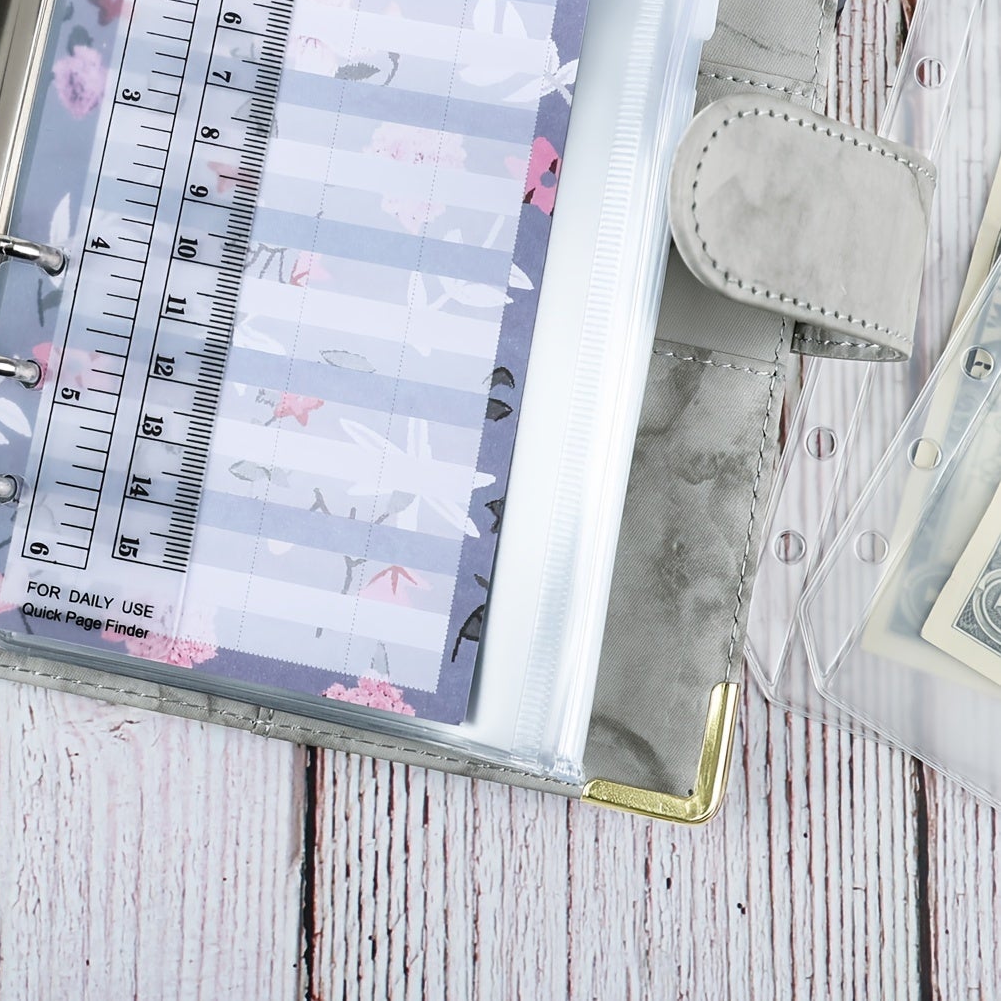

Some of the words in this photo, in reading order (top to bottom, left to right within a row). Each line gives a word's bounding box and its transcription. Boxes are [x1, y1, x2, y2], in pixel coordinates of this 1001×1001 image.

[223, 11, 242, 25] 6
[212, 69, 232, 83] 7
[121, 88, 141, 102] 3
[200, 125, 220, 139] 8
[189, 184, 209, 198] 9
[91, 236, 111, 250] 4
[177, 235, 199, 259] 10
[164, 294, 187, 315] 11
[153, 353, 175, 377] 12
[61, 386, 81, 401] 5
[142, 413, 164, 437] 13
[129, 473, 152, 497] 14
[29, 541, 50, 556] 6
[118, 534, 141, 558] 15
[26, 581, 61, 600] FOR
[69, 589, 114, 610] DAILY
[122, 601, 155, 619] USE
[22, 602, 63, 623] Quick
[65, 611, 102, 631] Page
[105, 619, 150, 640] Finder
